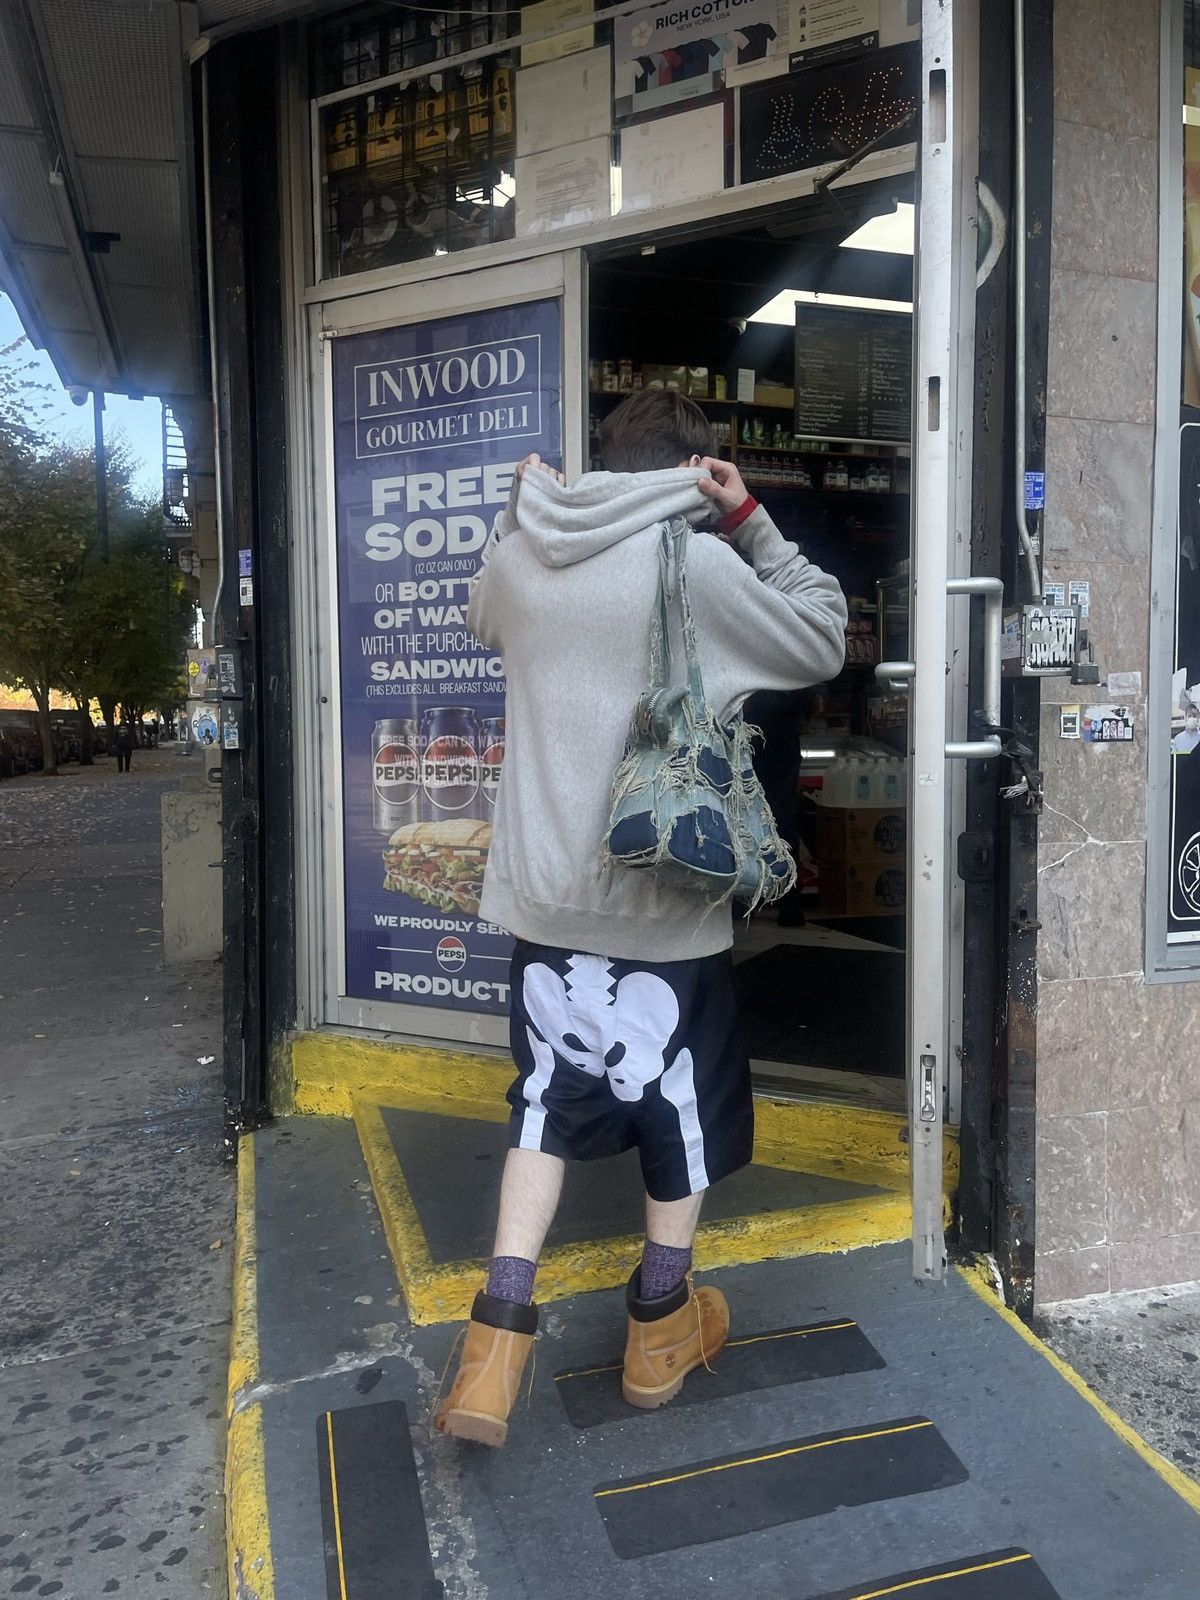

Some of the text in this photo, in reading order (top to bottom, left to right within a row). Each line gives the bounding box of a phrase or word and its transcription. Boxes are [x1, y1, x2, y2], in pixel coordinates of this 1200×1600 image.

[656, 0, 754, 30] RICH COTTO
[677, 21, 692, 32] NEW
[716, 11, 731, 21] USA
[368, 348, 525, 407] INWOOD
[366, 405, 528, 449] GOURMET DELI
[371, 461, 520, 517] FREE
[364, 514, 488, 561] SOD
[437, 560, 453, 573] CAN
[454, 559, 476, 572] ONLY)
[375, 577, 473, 603] OR BOTT
[374, 608, 413, 630] OF
[361, 631, 491, 656] WITH THE PURCHA
[370, 656, 505, 682] SANDWIC
[386, 683, 421, 696] EXCLUDES
[423, 683, 436, 695] ALL
[440, 682, 481, 694] BREAKFAST
[376, 766, 419, 781] PEPSI
[425, 764, 477, 782] PEPSI
[482, 766, 502, 782] PE
[374, 914, 510, 936] WE PROUDLY SER
[438, 949, 465, 959] PEPSI
[374, 970, 511, 1003] PRODUCT
